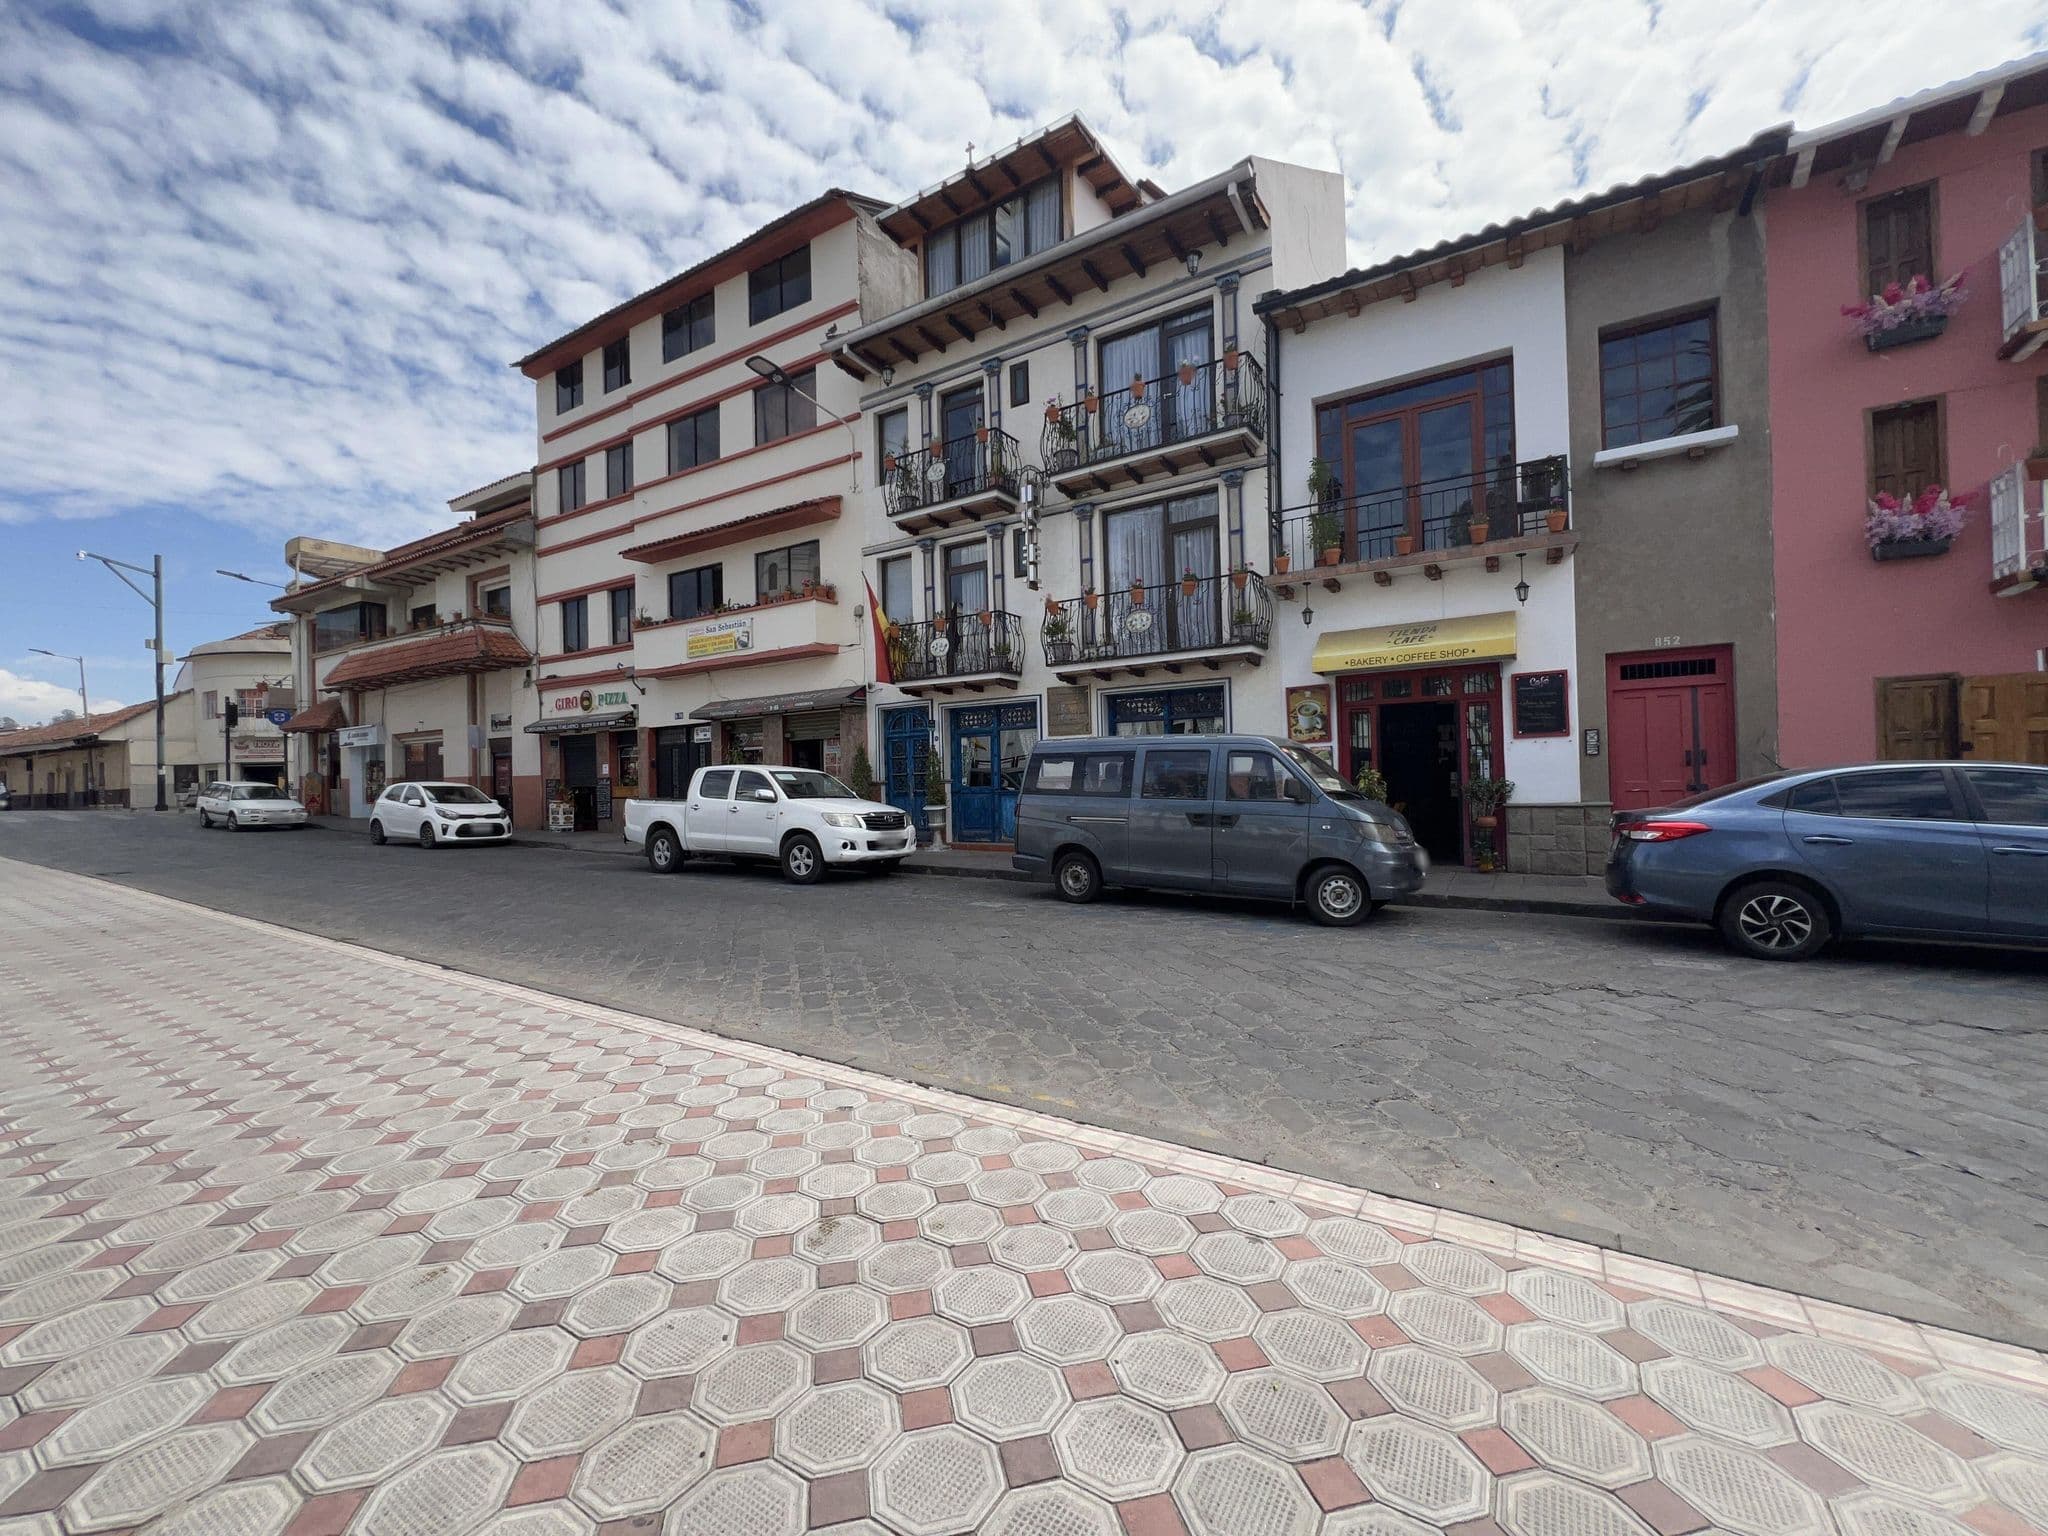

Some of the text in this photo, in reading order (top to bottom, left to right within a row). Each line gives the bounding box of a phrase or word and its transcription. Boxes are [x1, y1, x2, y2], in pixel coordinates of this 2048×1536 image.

[1388, 625, 1437, 638] TIENDA
[1654, 635, 1681, 647] 852
[1349, 648, 1470, 667] BAKERY COFFEE SHOP
[555, 691, 629, 711] GIRO PIZZA
